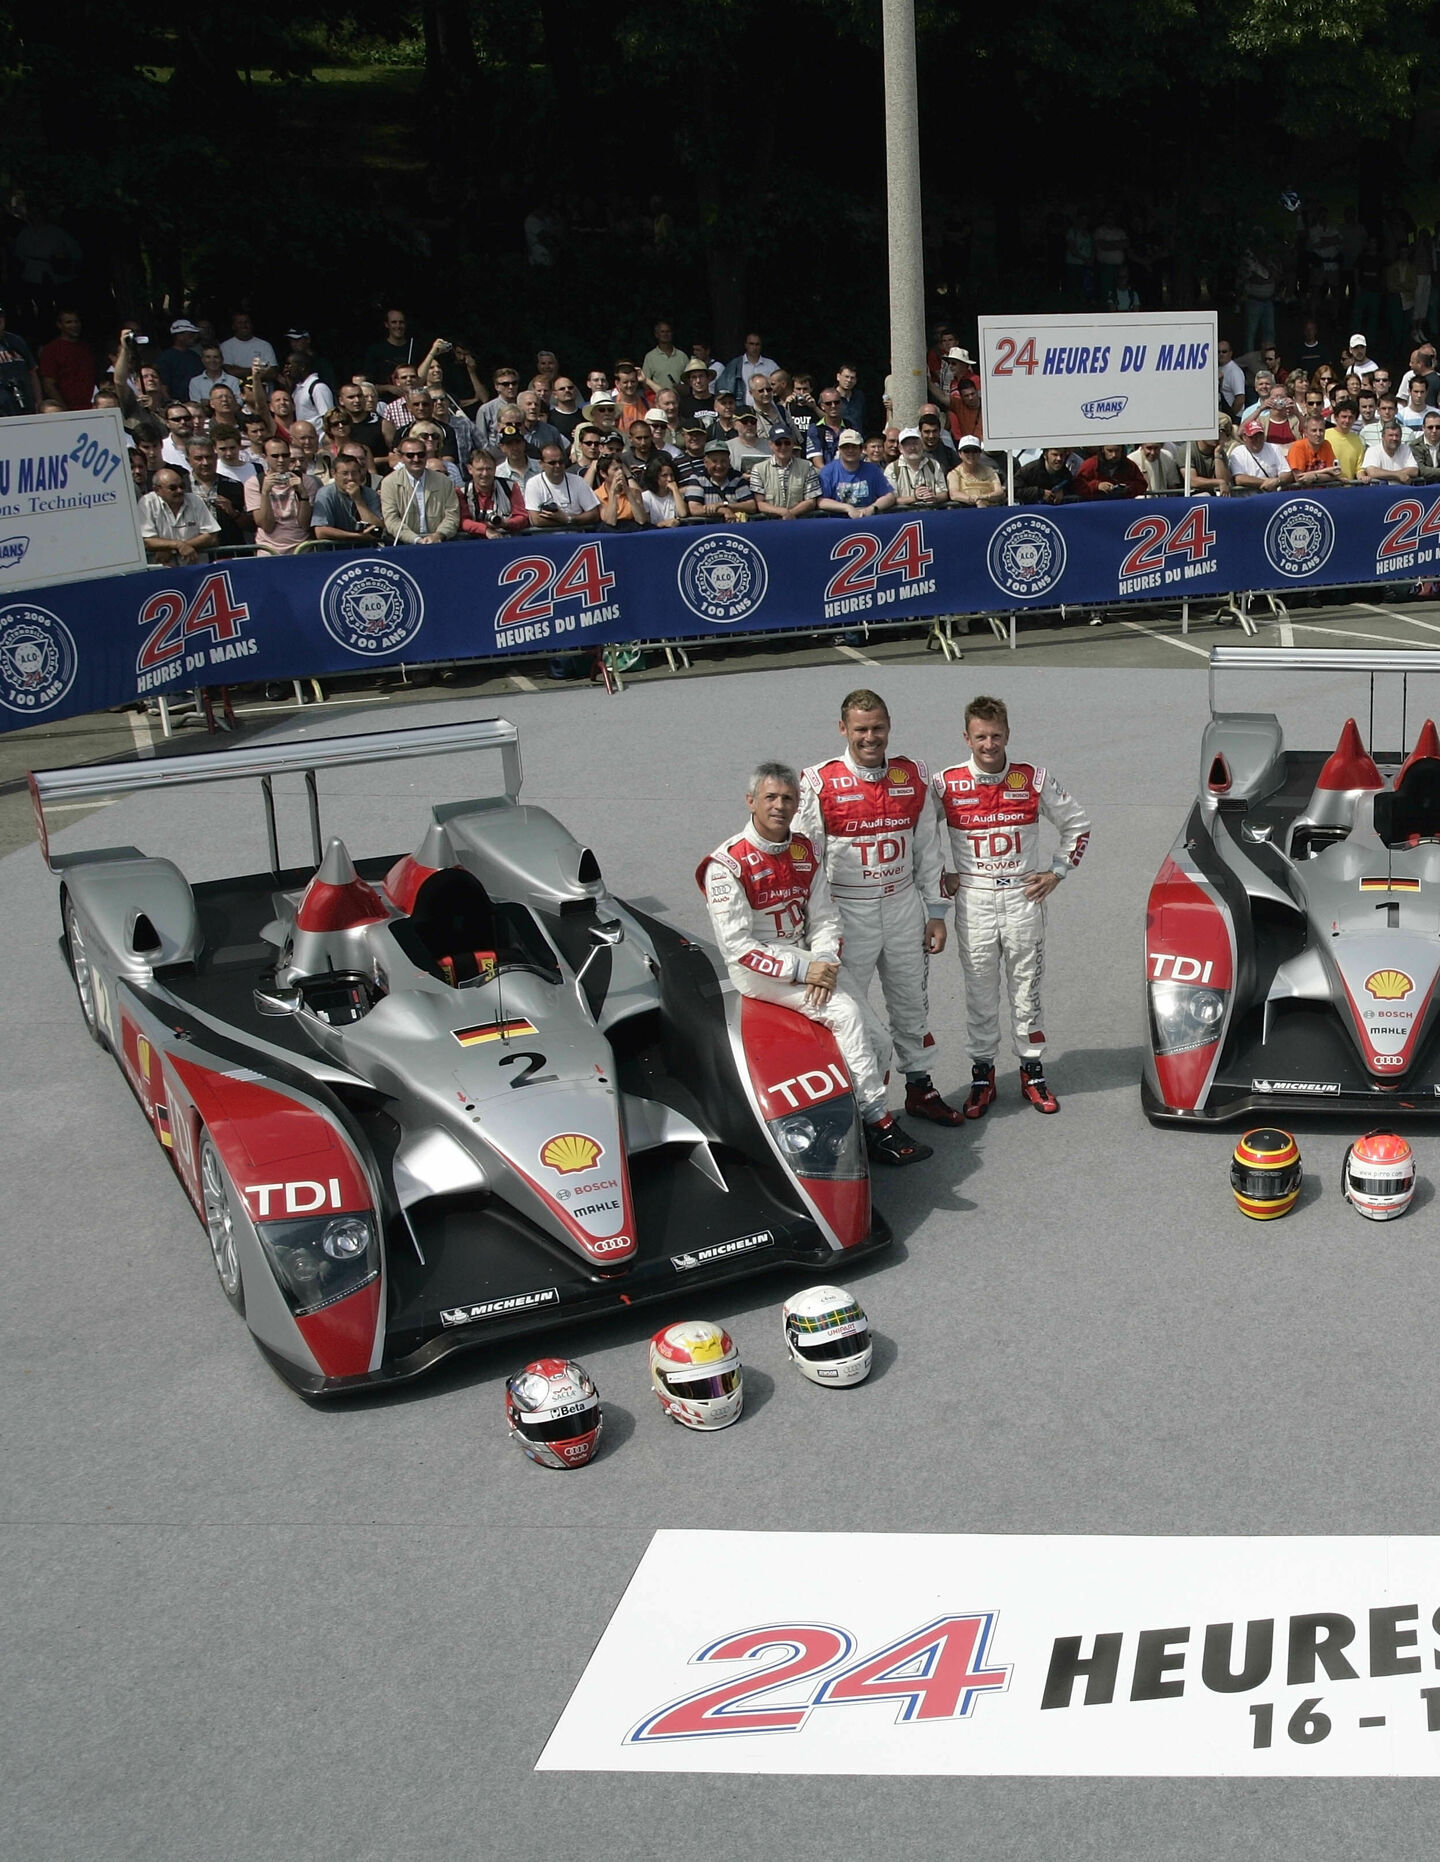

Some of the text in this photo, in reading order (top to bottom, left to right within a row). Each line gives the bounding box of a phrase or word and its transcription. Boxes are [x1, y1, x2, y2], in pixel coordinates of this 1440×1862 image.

[992, 337, 1210, 376] 24 HEURES DU MANS
[1085, 401, 1124, 414] LE MANS
[0, 432, 122, 496] U MANS 2007
[28, 490, 117, 513] Techniques
[0, 543, 24, 558] ANS
[1118, 504, 1216, 580] 24
[823, 519, 934, 602] 24
[1376, 553, 1416, 575] HEURES
[1417, 549, 1432, 564] DU
[337, 566, 400, 585] 1906 2006
[494, 541, 616, 631] 24
[1006, 575, 1051, 592] 100 ANS
[1119, 559, 1217, 596] HEURES DU MANS
[701, 597, 751, 616] 100 ANS
[824, 578, 936, 619] HEURES DU MANS
[136, 569, 251, 674] 24
[496, 603, 620, 649] HEURES DU MANS
[349, 628, 407, 649] 100 ANS
[137, 638, 257, 695] HEURES DU MANS
[9, 680, 63, 706] 100 ANS
[829, 776, 858, 789] TDI
[947, 779, 975, 792] TDI
[860, 817, 911, 829] Audi Sport
[972, 812, 1025, 822] Audi Sport
[852, 836, 906, 866] TDI
[967, 831, 1022, 858] TDI
[741, 851, 764, 866] TDI
[976, 860, 1021, 872] Power
[863, 866, 905, 880] Power
[1375, 901, 1400, 929] 1
[749, 952, 779, 976] TDI
[1149, 953, 1213, 984] TDI
[1378, 1010, 1413, 1019] BOSCH
[1370, 1026, 1407, 1036] MAHLE
[498, 1051, 561, 1090] 2
[768, 1063, 850, 1109] TDI
[1272, 1081, 1338, 1092] MICHELIN
[244, 1177, 343, 1217] TDI
[574, 1179, 618, 1196] BOSCH
[573, 1199, 620, 1218] MAHLE
[697, 1232, 770, 1261] MICHELIN
[470, 1289, 554, 1317] MICHELIN
[560, 1403, 585, 1416] Beta
[621, 1609, 1014, 1746] 24
[1249, 1698, 1332, 1751] 16
